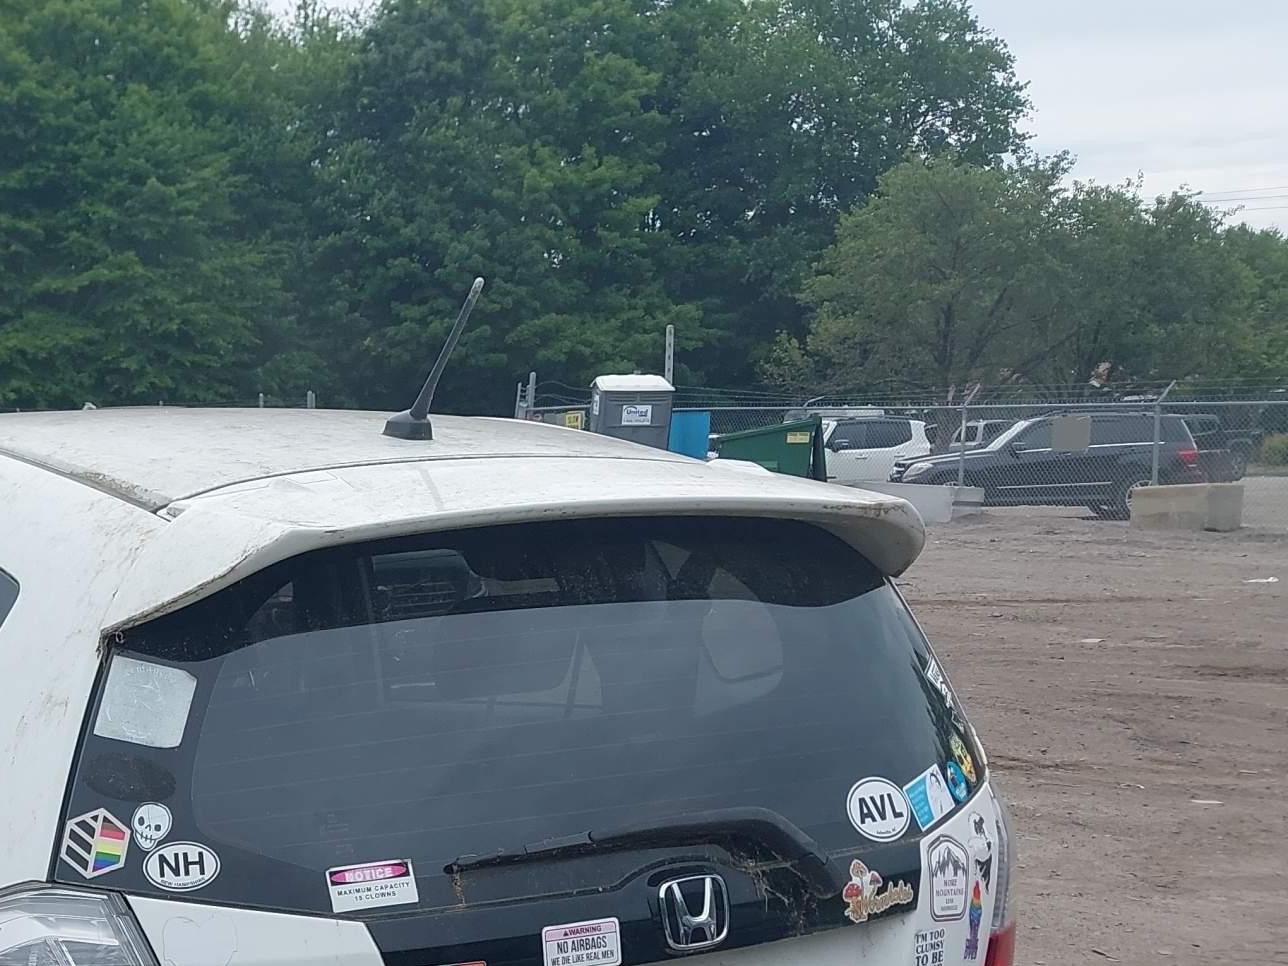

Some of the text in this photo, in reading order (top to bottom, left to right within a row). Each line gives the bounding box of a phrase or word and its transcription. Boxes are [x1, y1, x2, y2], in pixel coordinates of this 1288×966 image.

[858, 793, 904, 825] AVL
[158, 851, 205, 878] NH
[344, 867, 393, 882] NOTICE
[337, 881, 410, 896] MAXIMUM CAPACITY
[365, 890, 397, 900] CLOWNS
[568, 925, 602, 936] WARNING
[929, 928, 945, 942] TOO
[556, 935, 608, 954] NO AIRBAGS
[915, 940, 944, 954] CLUMSY
[550, 949, 615, 966] WE DIE LIKE REAL MEN
[931, 950, 944, 964] BE
